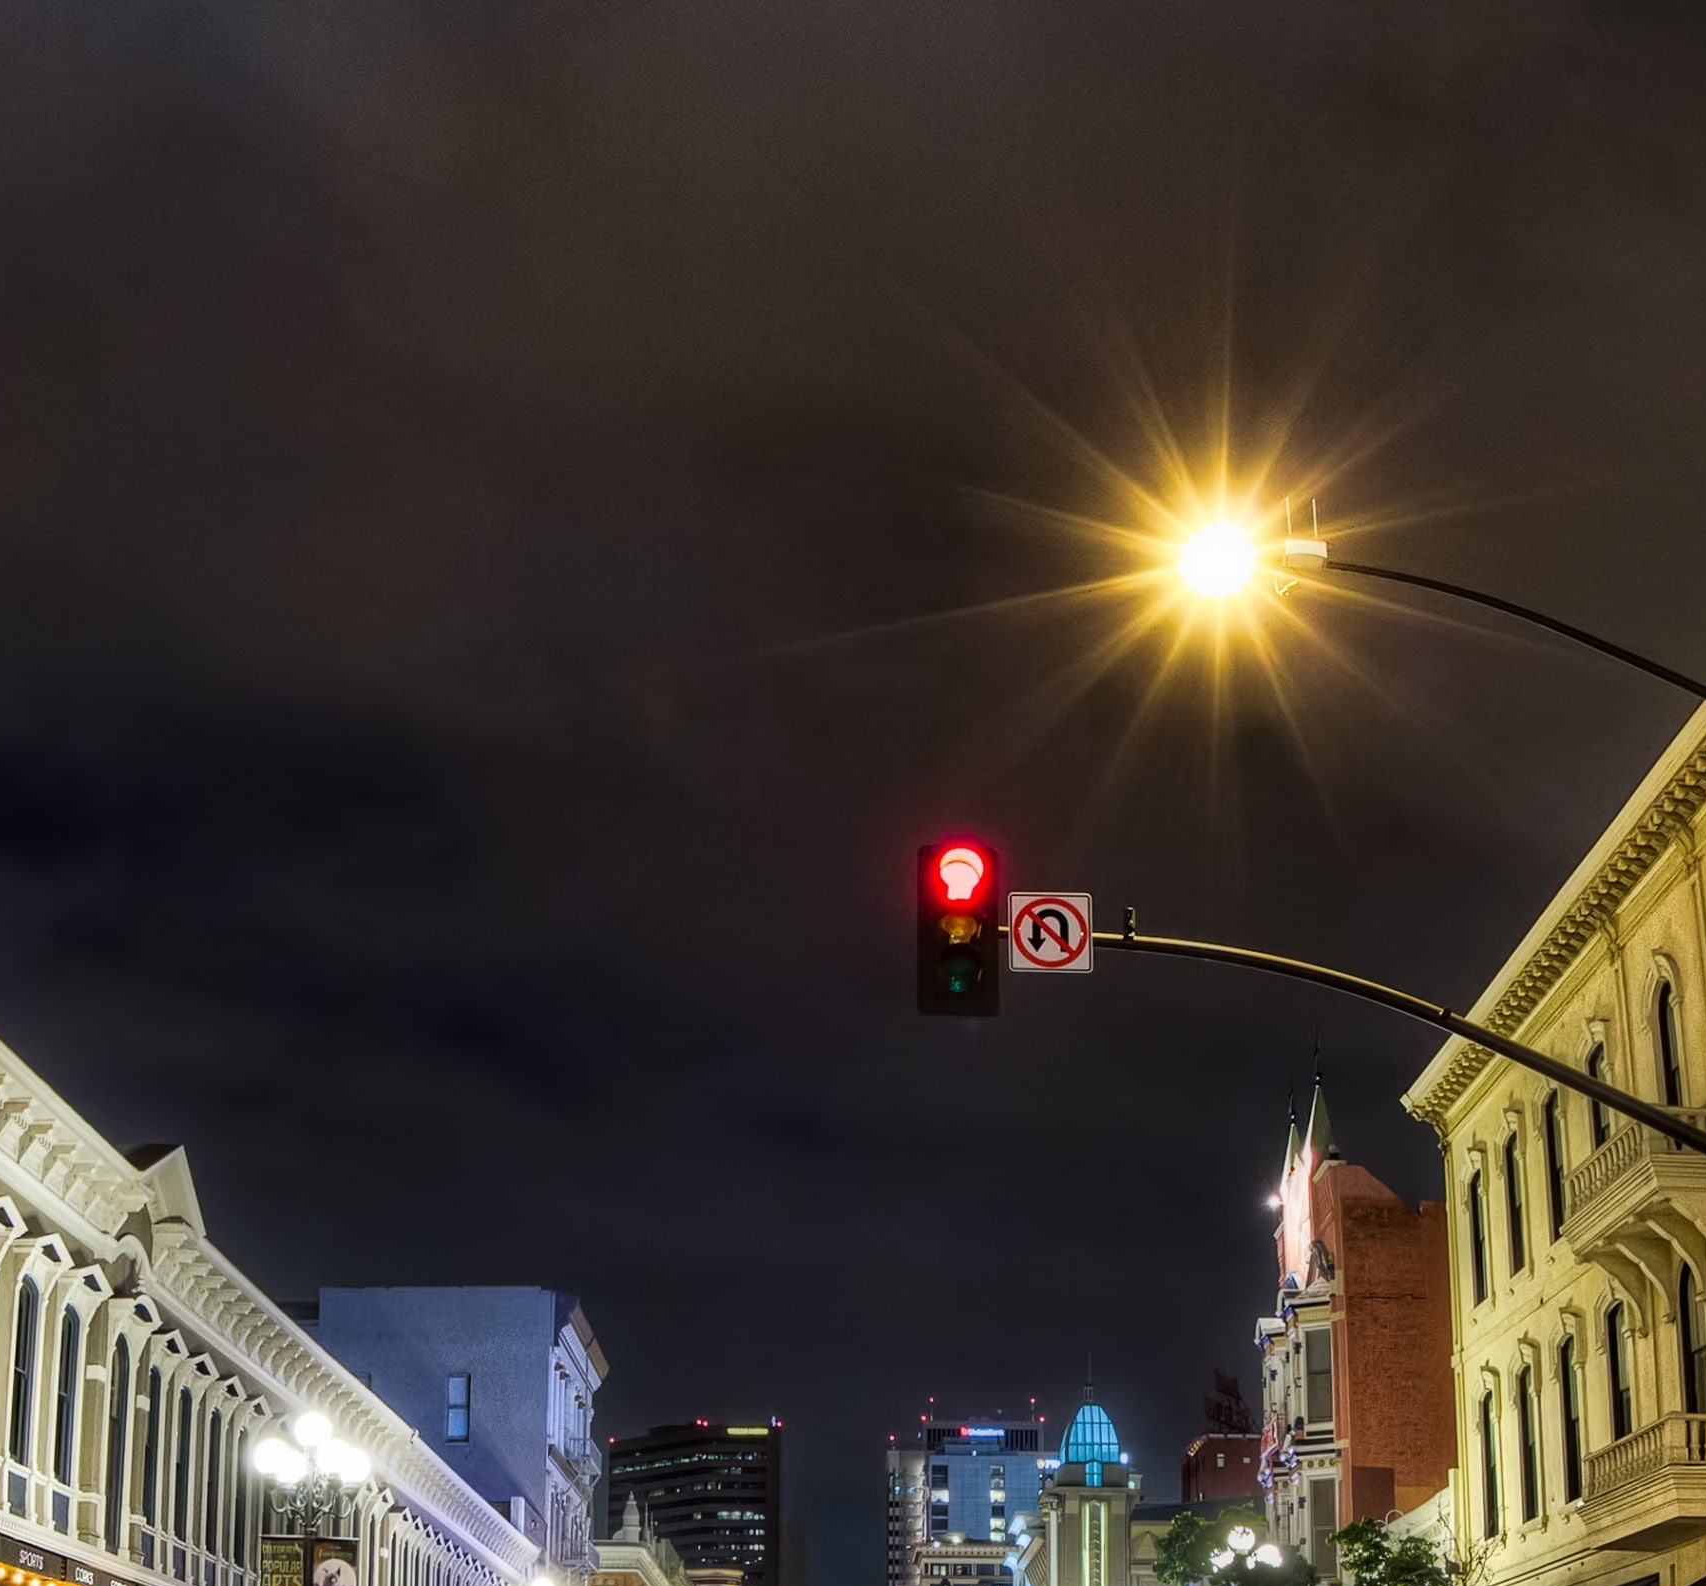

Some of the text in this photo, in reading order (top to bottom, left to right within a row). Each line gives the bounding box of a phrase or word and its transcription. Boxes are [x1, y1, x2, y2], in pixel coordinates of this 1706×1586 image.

[19, 1550, 44, 1570] SPORTS
[262, 1560, 302, 1573] POPULAR
[75, 1567, 93, 1586] CORKS
